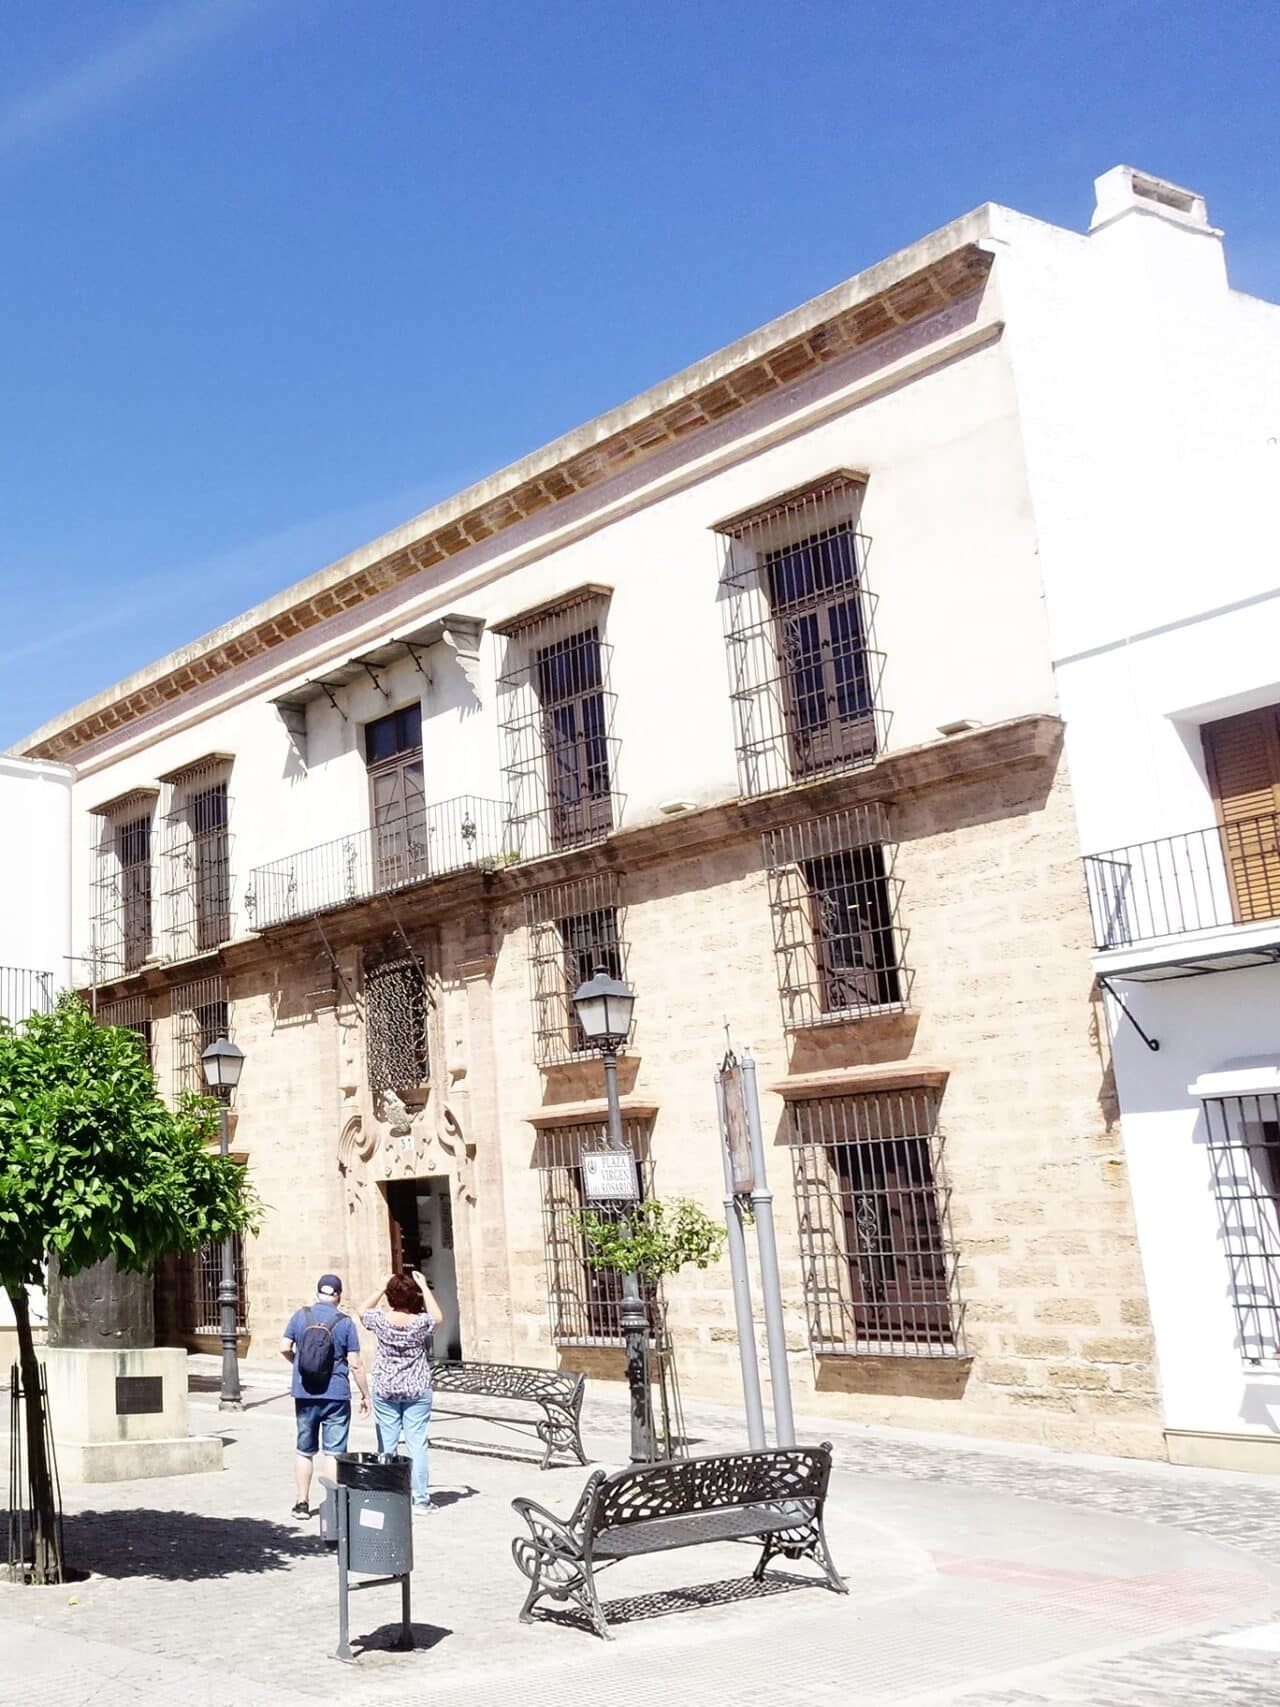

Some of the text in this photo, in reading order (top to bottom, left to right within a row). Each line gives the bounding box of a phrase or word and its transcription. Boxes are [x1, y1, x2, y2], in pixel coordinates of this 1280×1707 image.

[601, 1157, 627, 1168] PLAZA
[601, 1169, 630, 1181] VIRGEN
[601, 1182, 633, 1194] ROSARIO
